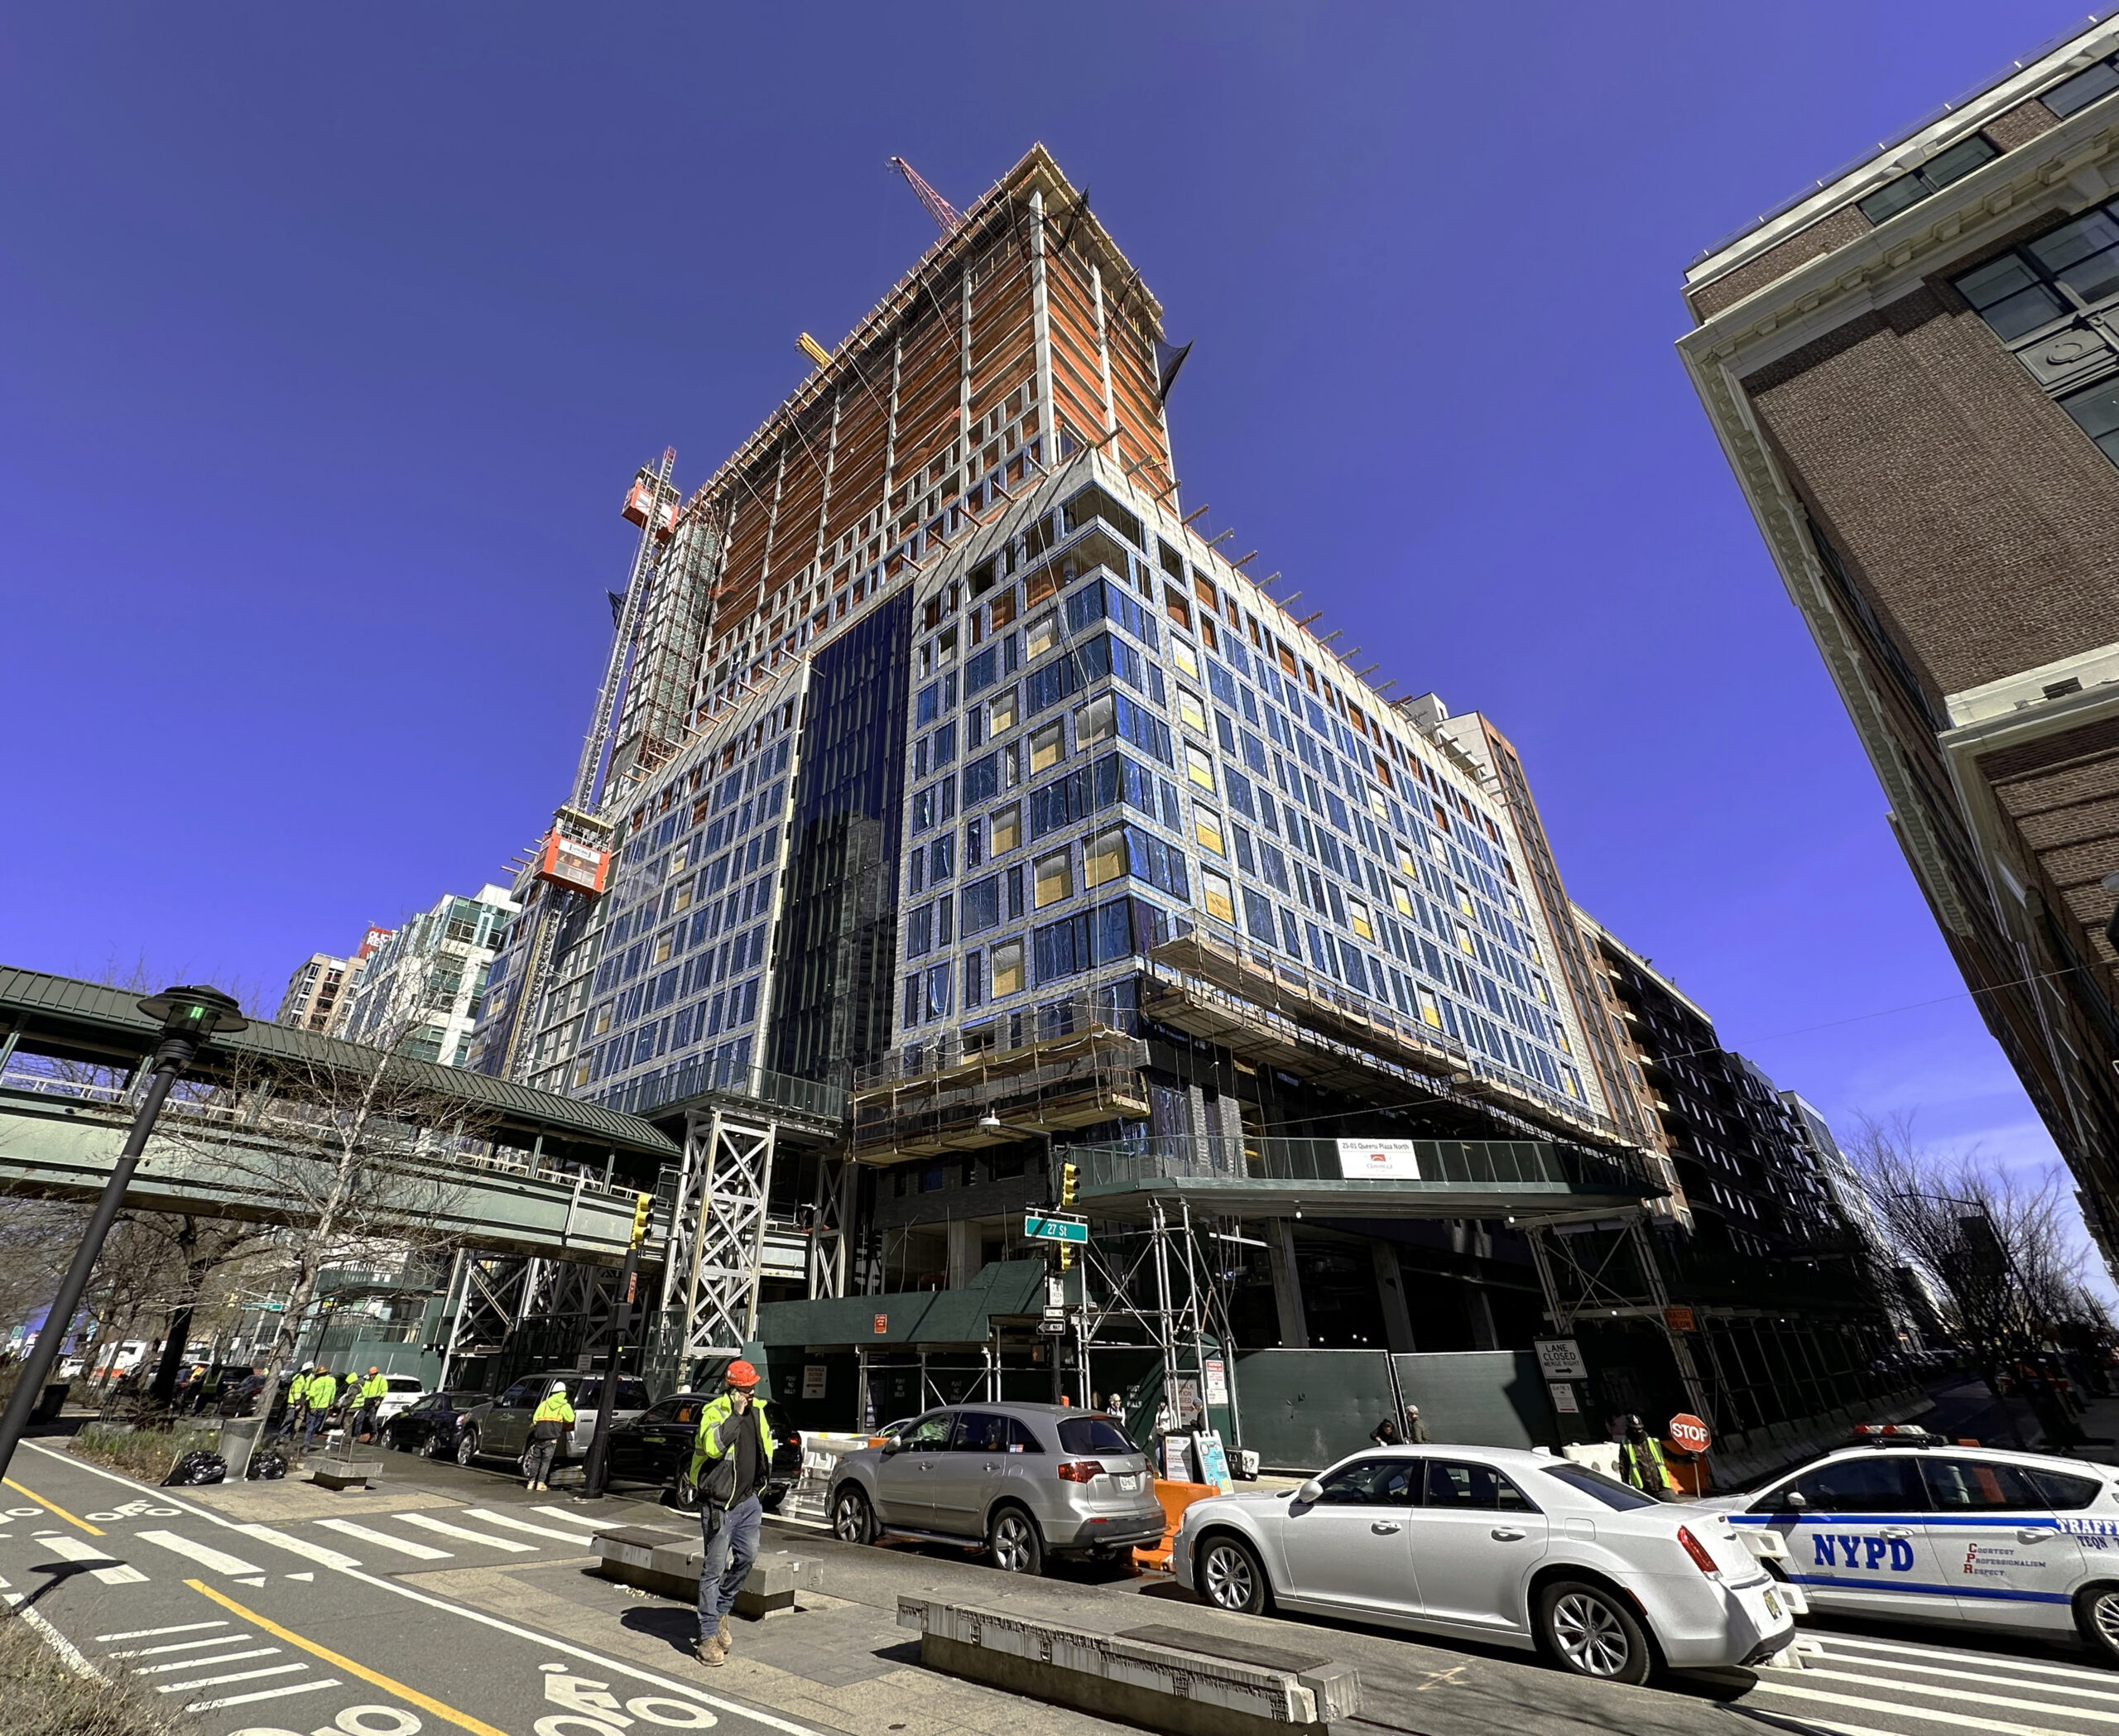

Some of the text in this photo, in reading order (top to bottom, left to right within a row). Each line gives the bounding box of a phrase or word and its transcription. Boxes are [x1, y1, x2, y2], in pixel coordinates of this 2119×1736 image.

[1047, 1223, 1067, 1237] 27 St
[1545, 1344, 1569, 1353] LANE
[1543, 1352, 1576, 1361] CLOSED
[1672, 1422, 1708, 1443] STOP
[1968, 1542, 2014, 1556] COURTESY
[2076, 1536, 2109, 1551] TEQN
[1812, 1533, 1914, 1572] NYPD
[1965, 1553, 2046, 1568] PROFESSIONALISM
[1963, 1564, 2005, 1576] RESPECT
